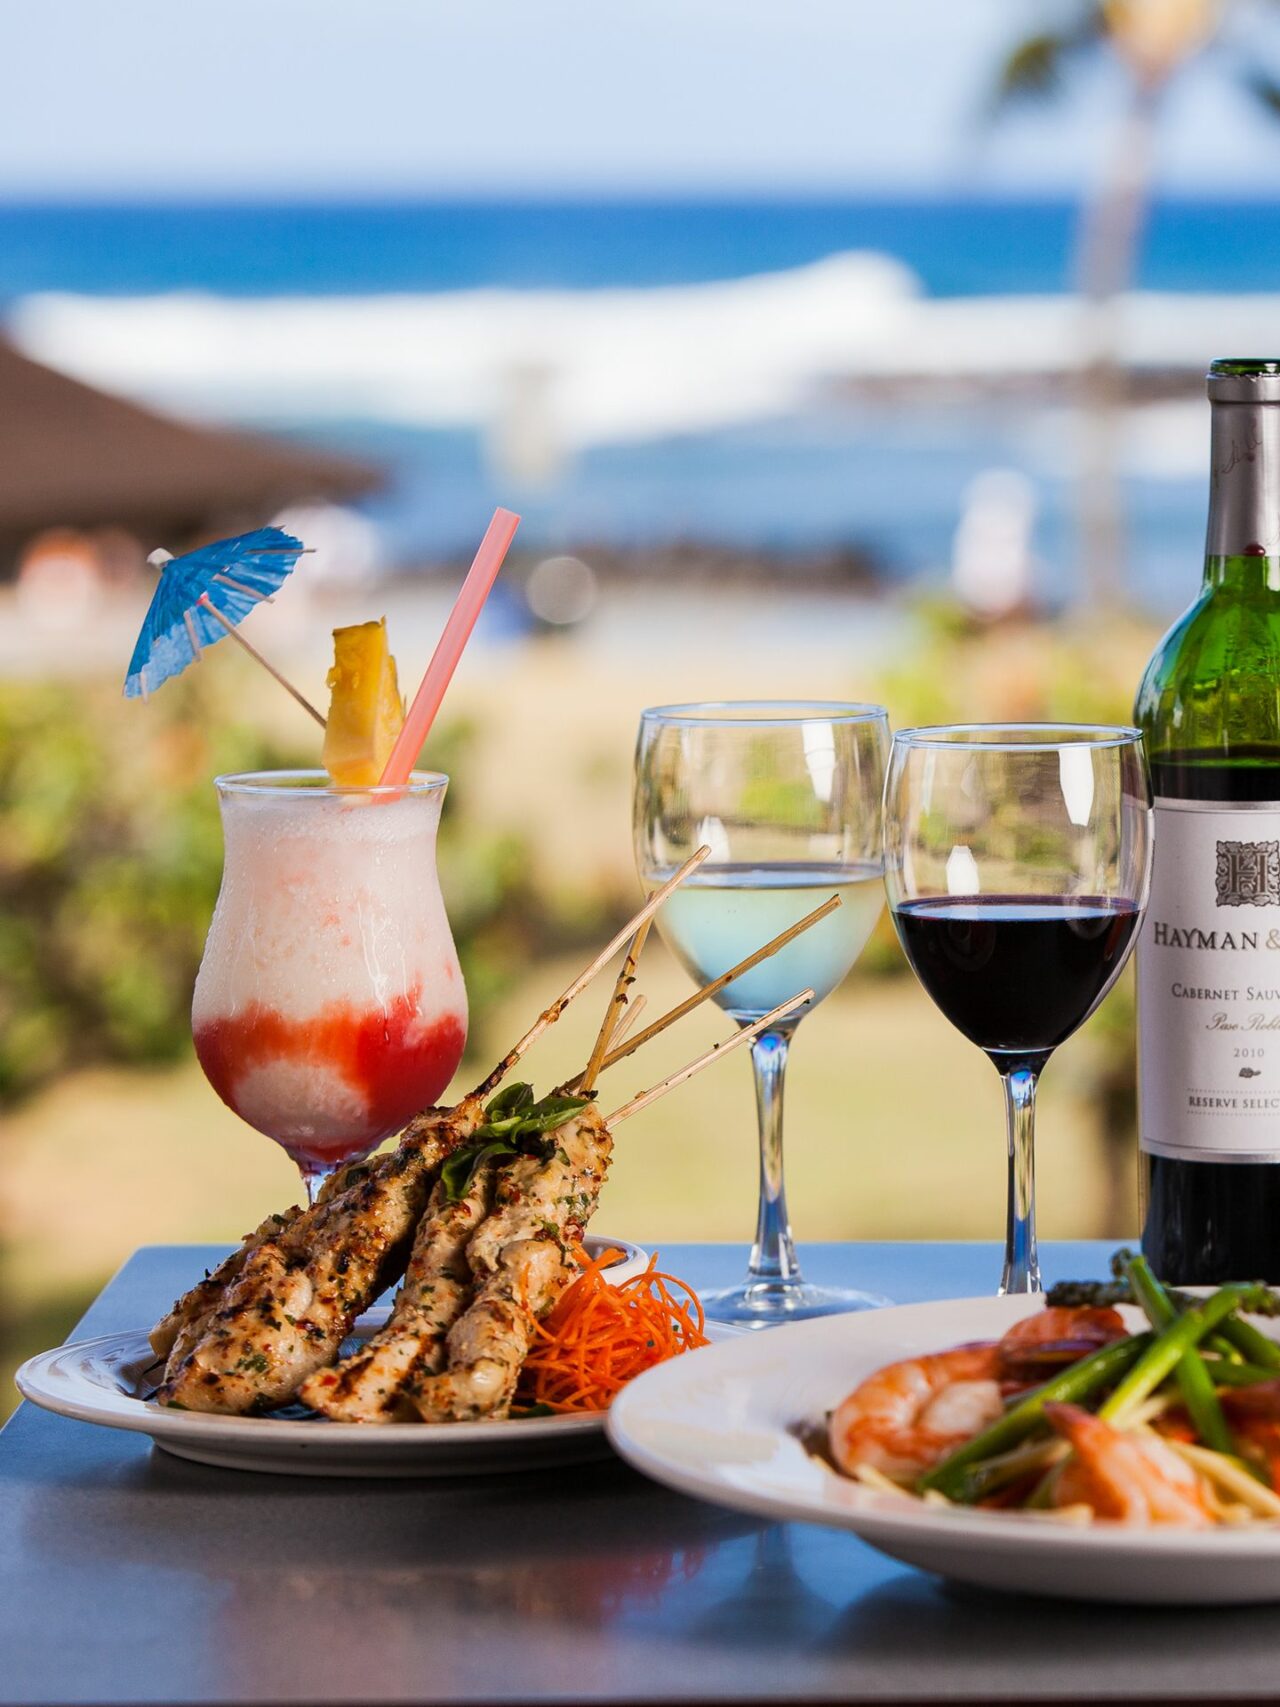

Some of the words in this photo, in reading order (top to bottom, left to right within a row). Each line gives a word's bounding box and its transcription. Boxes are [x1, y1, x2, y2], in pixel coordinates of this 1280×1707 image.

[1154, 922, 1258, 950] HAYMAN
[1171, 983, 1239, 1001] CABERNET
[1234, 1048, 1265, 1058] 2010
[1188, 1096, 1237, 1109] RESERVE
